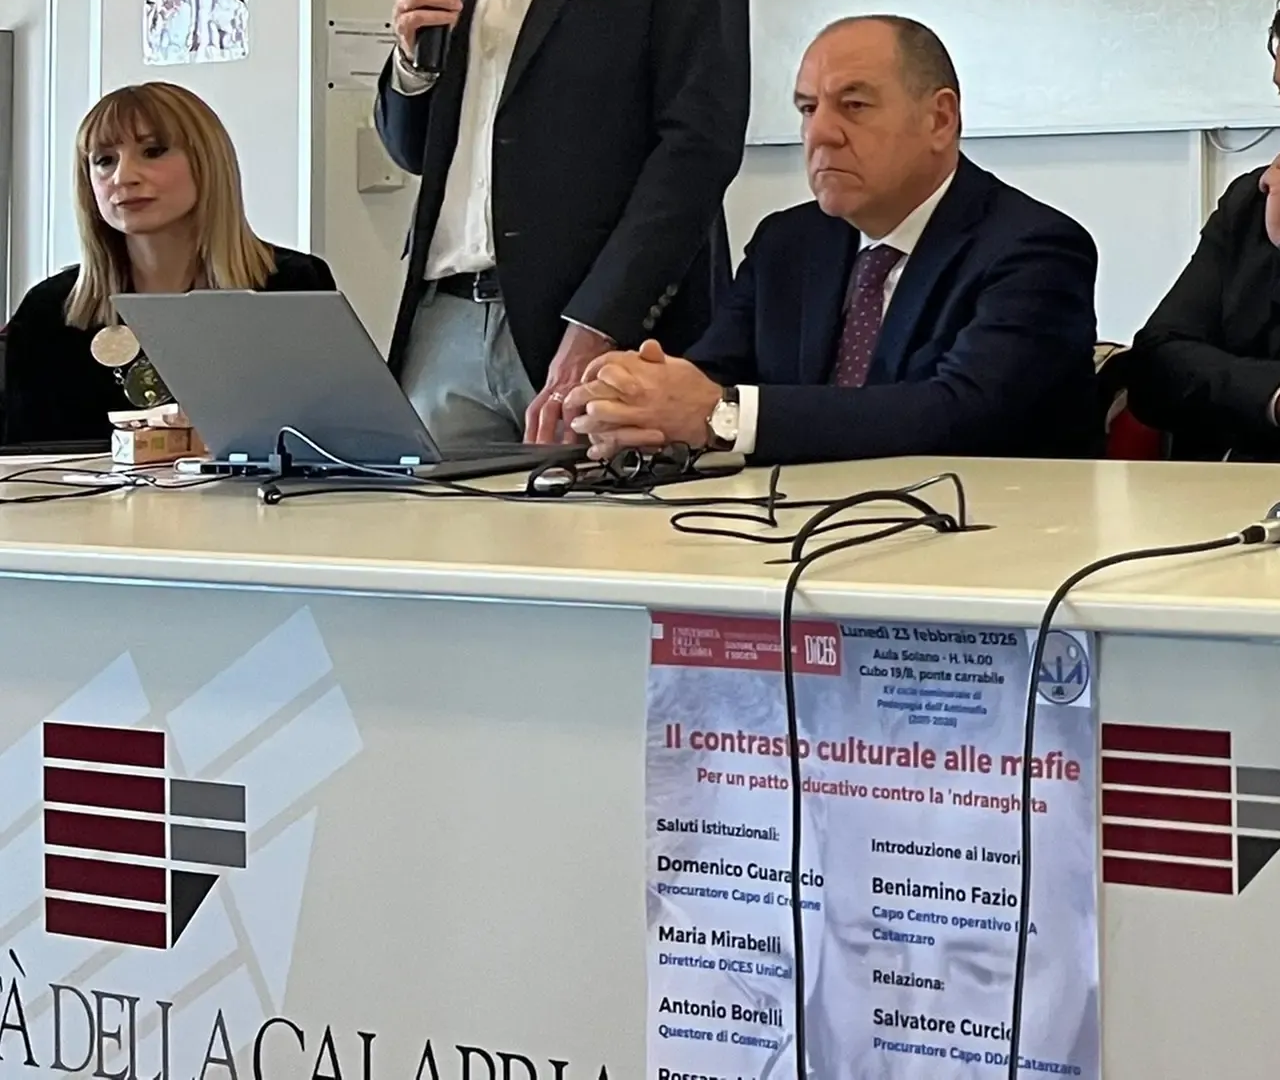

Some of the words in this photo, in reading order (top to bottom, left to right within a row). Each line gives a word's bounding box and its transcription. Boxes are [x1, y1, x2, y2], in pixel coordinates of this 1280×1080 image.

[840, 624, 890, 640] Lunedì
[892, 627, 910, 642] 23
[914, 626, 977, 645] febbraio
[873, 648, 898, 661] Aula
[964, 652, 993, 666] 14.00
[859, 664, 888, 677] Cubo
[919, 669, 952, 684] ponte
[954, 670, 1005, 686] carrabile
[665, 724, 681, 749] Il
[816, 735, 937, 770] culturale
[944, 744, 992, 774] alle
[1000, 751, 1081, 782] mafie
[696, 768, 723, 785] Per
[725, 772, 745, 787] un
[748, 774, 789, 792] patto
[799, 775, 869, 799] ducativo
[871, 785, 925, 805] contro
[929, 789, 944, 806] la
[946, 789, 1048, 814] 'ndranghta
[656, 819, 698, 833] Saluti
[871, 838, 962, 859] Introduzione
[965, 845, 978, 861] ai
[981, 847, 1021, 865] lavori
[656, 855, 743, 878] Domenico
[746, 862, 825, 888] Guaracio
[657, 882, 729, 901] Procuratore
[731, 889, 761, 905] Capo
[763, 892, 774, 905] di
[776, 894, 822, 911] Crone
[871, 876, 967, 903] Beniamino
[970, 886, 1018, 908] Fazio
[871, 905, 905, 922] Capo
[906, 908, 949, 926] Centro
[951, 915, 1012, 934] operativo
[658, 925, 707, 946] Maria
[710, 930, 782, 955] Mirabelli
[871, 927, 936, 947] Catanzaro
[658, 953, 716, 970] Direttrice
[718, 958, 754, 974] DiCES
[755, 962, 793, 980] UniCal
[658, 996, 727, 1020] Antonio
[730, 1003, 783, 1028] Borelli
[872, 1007, 956, 1034] Salvatore
[658, 1024, 714, 1042] Questore
[715, 1029, 729, 1042] di
[730, 1031, 779, 1052] Cosenza
[872, 1036, 947, 1058] Procuratore
[949, 1046, 982, 1064] Capo
